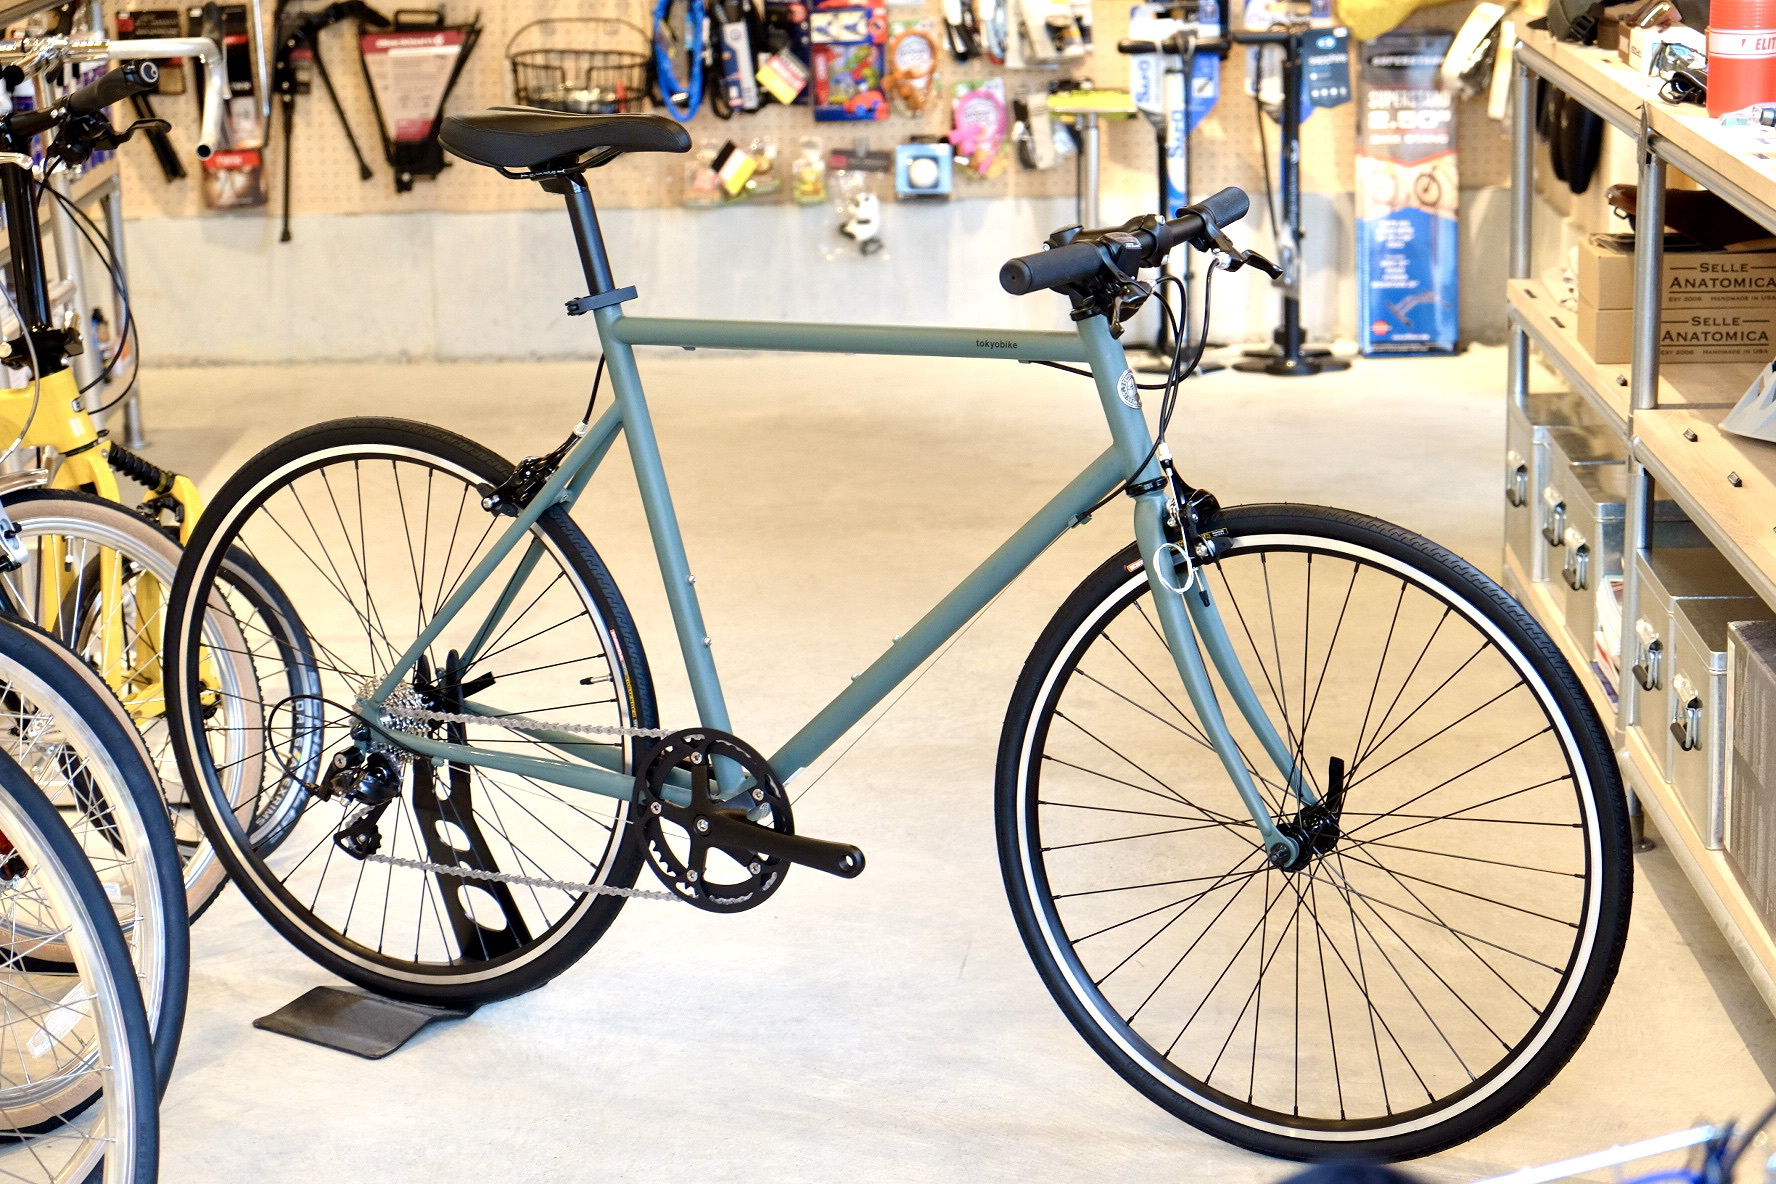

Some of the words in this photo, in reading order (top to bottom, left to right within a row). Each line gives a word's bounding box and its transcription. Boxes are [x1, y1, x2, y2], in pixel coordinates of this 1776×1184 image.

[1699, 262, 1749, 273] SELLE
[1669, 277, 1776, 289] ANATOMICA
[1691, 316, 1741, 327] SELLE
[1661, 330, 1769, 342] ANATOMICA
[976, 339, 1018, 349] tokyobike
